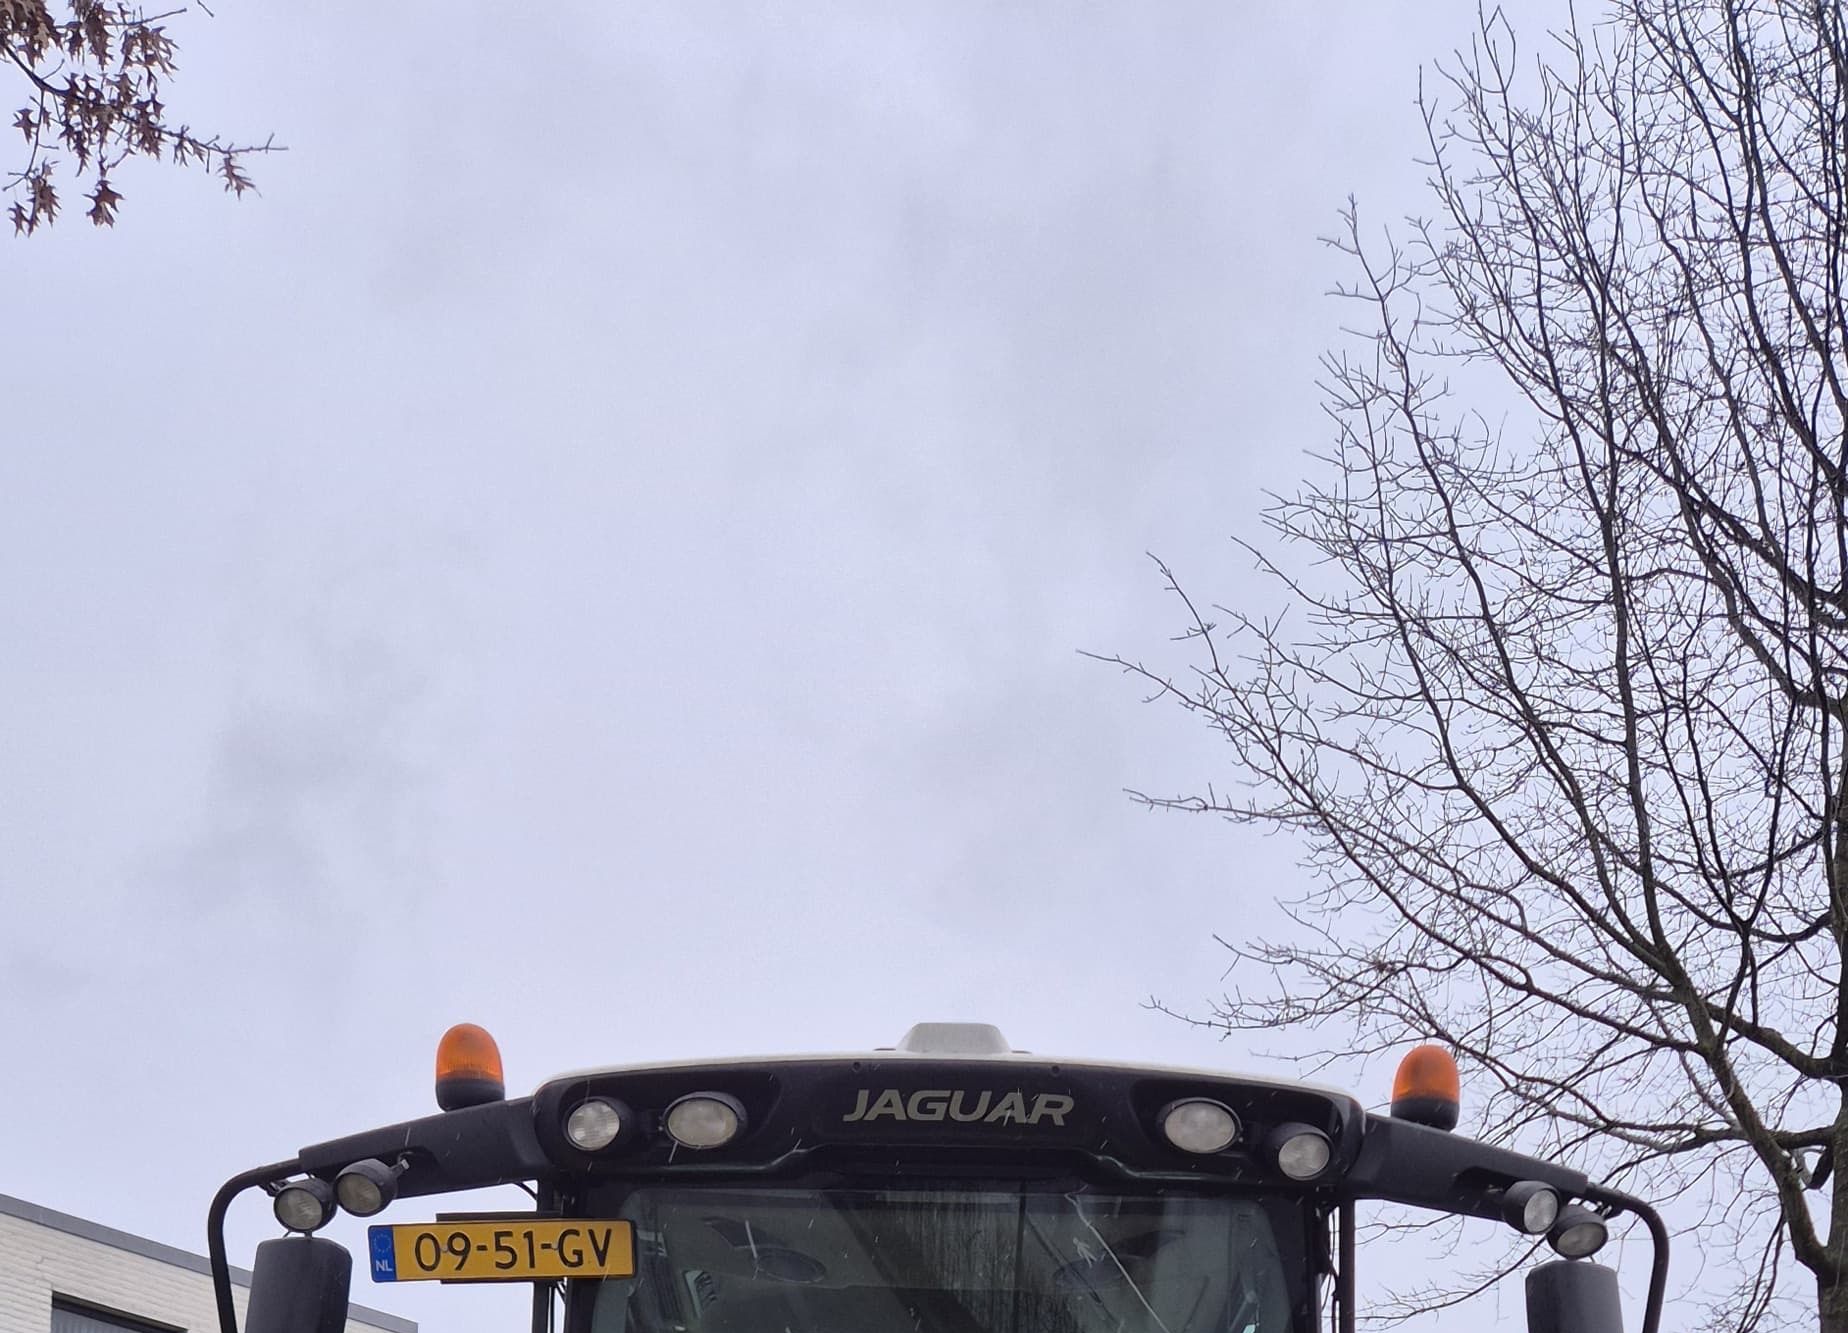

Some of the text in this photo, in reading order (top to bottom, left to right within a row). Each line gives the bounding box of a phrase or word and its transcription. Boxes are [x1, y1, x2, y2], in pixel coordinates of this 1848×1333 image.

[843, 1088, 1074, 1126] JAGUAR
[375, 1260, 393, 1272] NL
[414, 1228, 612, 1272] 09-51-GV
